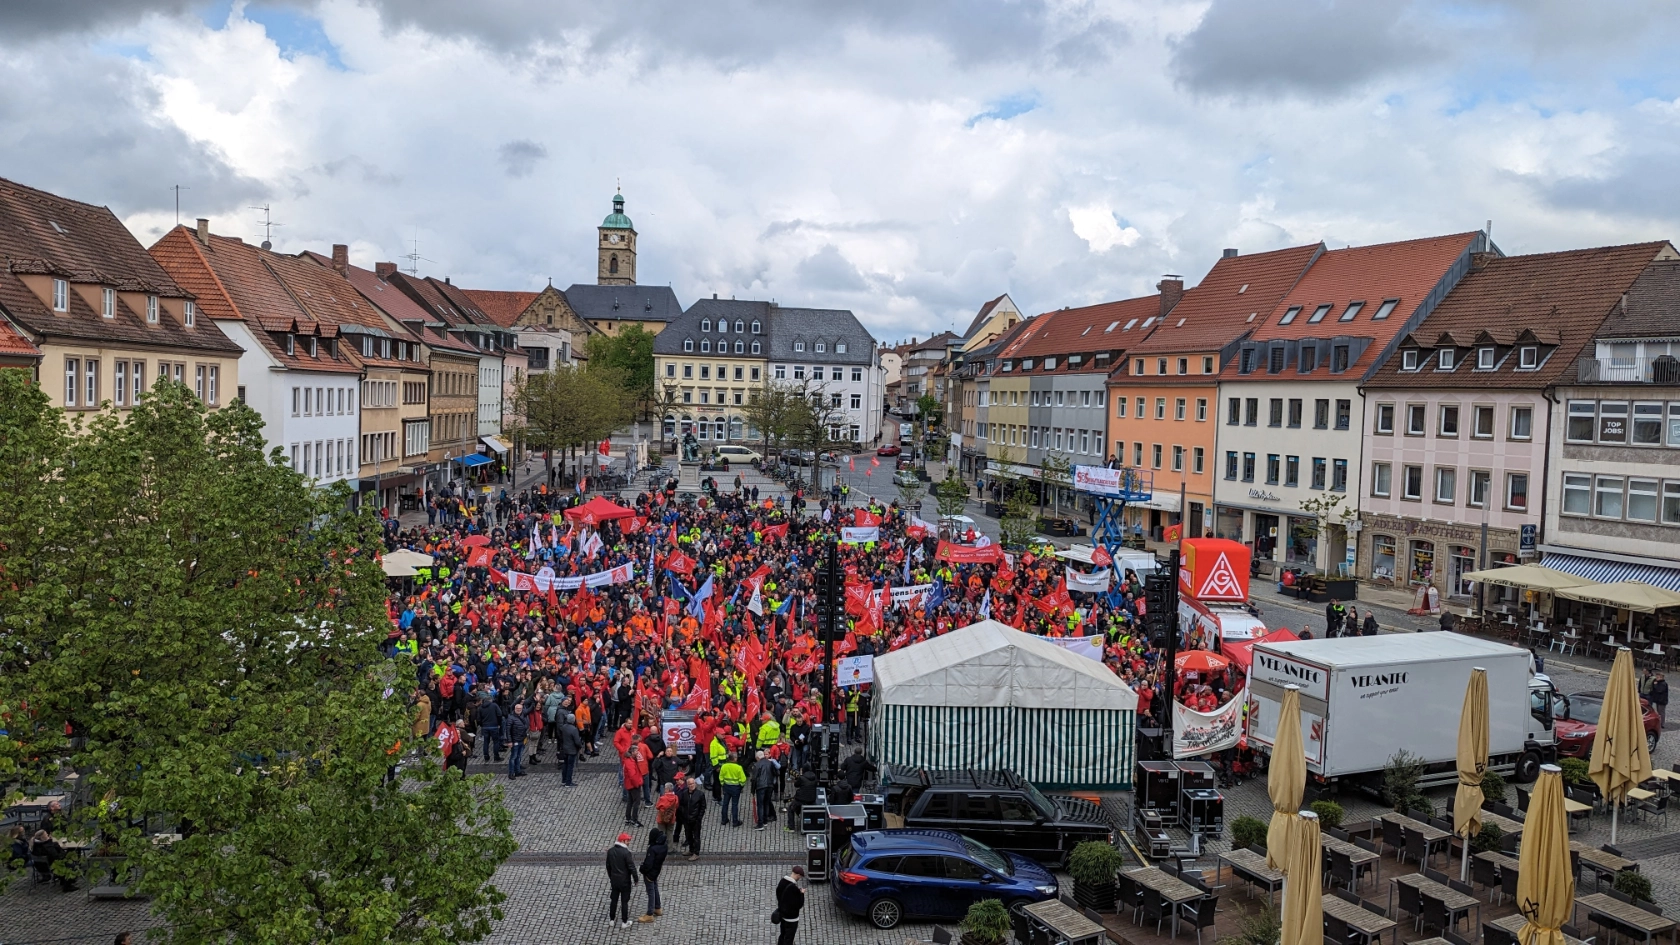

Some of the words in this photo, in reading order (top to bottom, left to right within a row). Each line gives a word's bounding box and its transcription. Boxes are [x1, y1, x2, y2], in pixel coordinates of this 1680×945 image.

[1373, 519, 1404, 532] ADLER
[1419, 525, 1475, 541] APOTHEKE
[1591, 597, 1607, 605] Café
[1259, 655, 1321, 684] VERANTEC
[1351, 671, 1410, 688] VERANTEC
